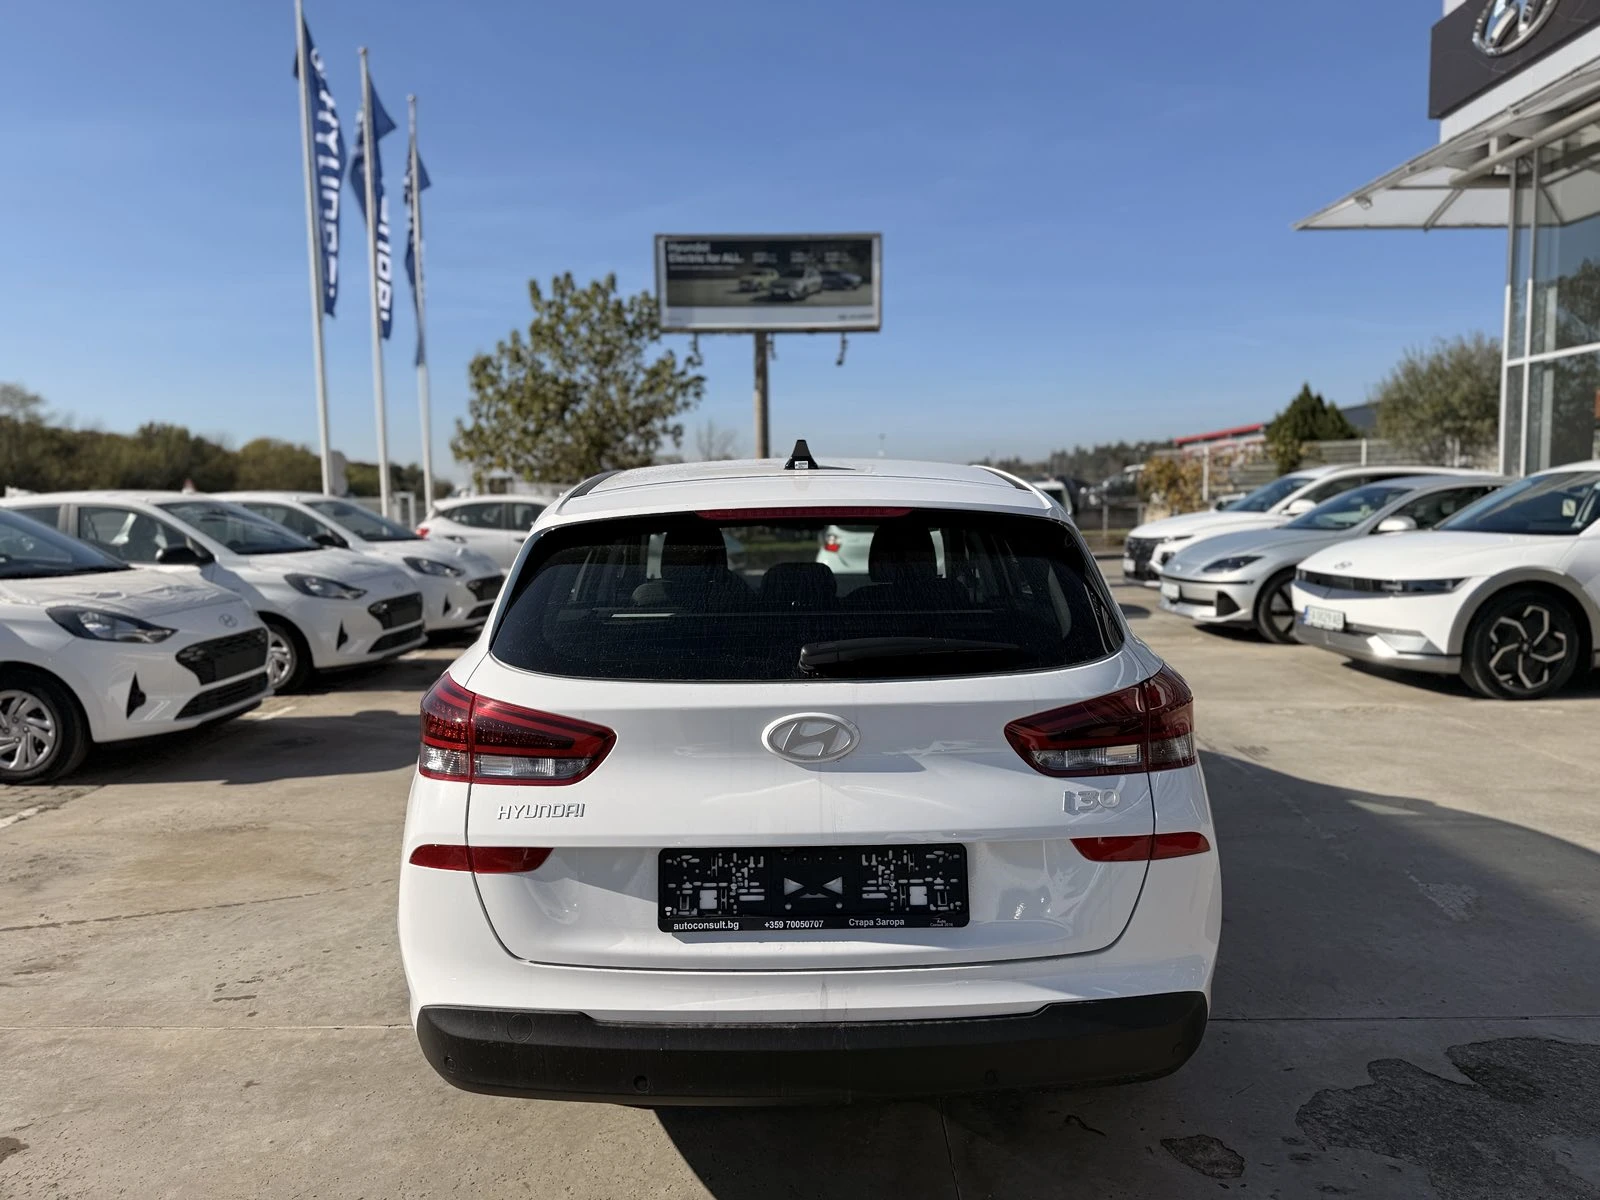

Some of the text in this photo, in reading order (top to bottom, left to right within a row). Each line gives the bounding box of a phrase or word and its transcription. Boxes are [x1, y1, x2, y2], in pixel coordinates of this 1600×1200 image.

[497, 803, 586, 820] HYUNDAI
[673, 920, 740, 931] autoconsult.bg
[764, 920, 824, 929] +359 70050707
[848, 917, 905, 928] Стара Загора
